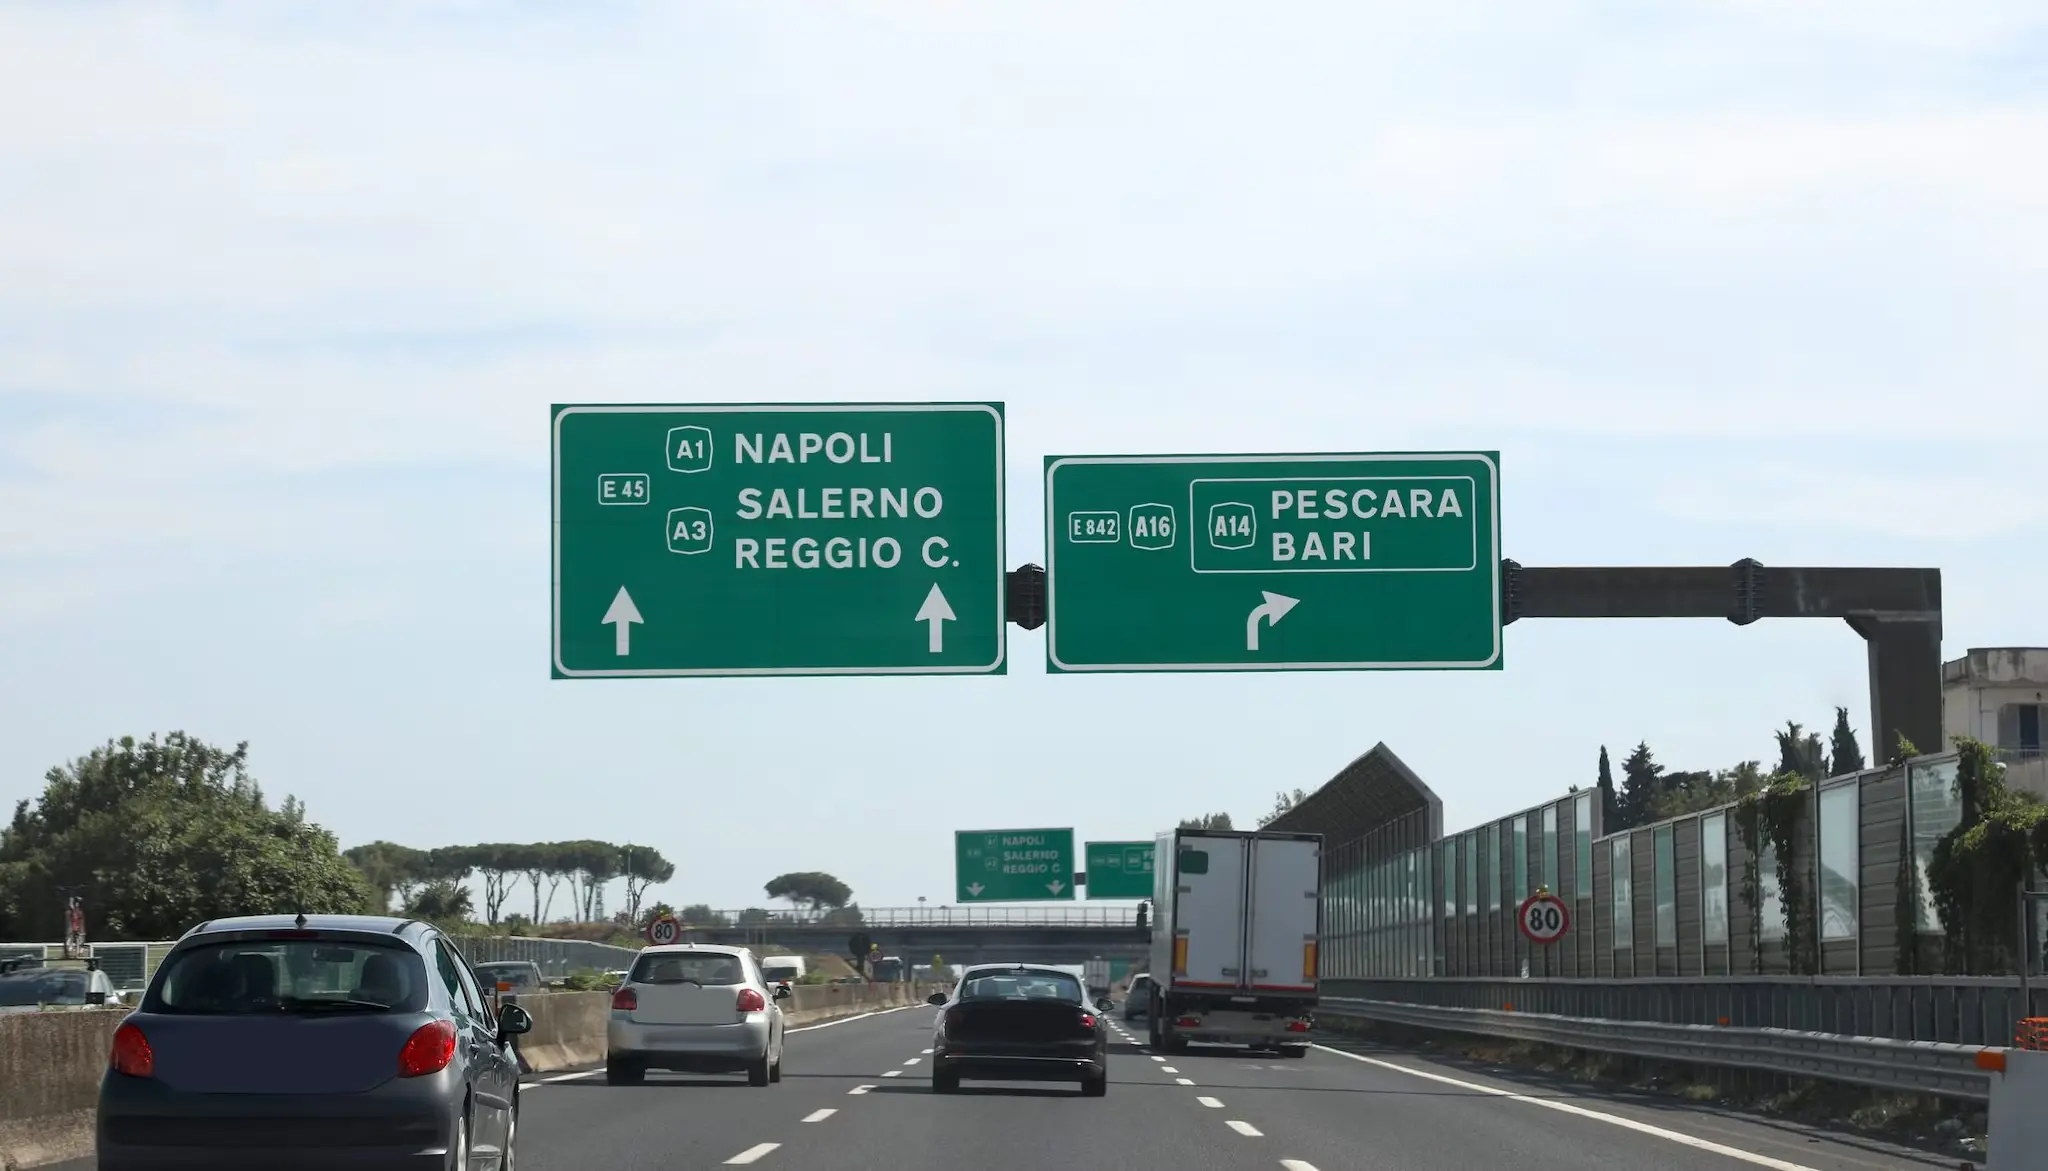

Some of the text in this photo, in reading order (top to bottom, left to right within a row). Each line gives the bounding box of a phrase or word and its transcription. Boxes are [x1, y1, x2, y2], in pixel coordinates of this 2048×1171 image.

[676, 439, 704, 459] A1
[735, 432, 892, 463] NAPOLI
[603, 480, 644, 498] E 45
[736, 487, 943, 519] SALERNO
[1271, 488, 1463, 519] PESCARA
[673, 521, 706, 541] A3
[1073, 518, 1116, 536] E 842
[1135, 515, 1170, 537] A16
[1214, 515, 1251, 537] A14
[735, 536, 960, 568] REGGIO C.
[1272, 531, 1371, 561] BARI
[1002, 835, 1045, 846] NAPOLI
[1003, 850, 1059, 861] SALERNO
[1003, 863, 1047, 874] REGGIO
[1530, 908, 1559, 931] 80
[655, 923, 672, 938] 80
